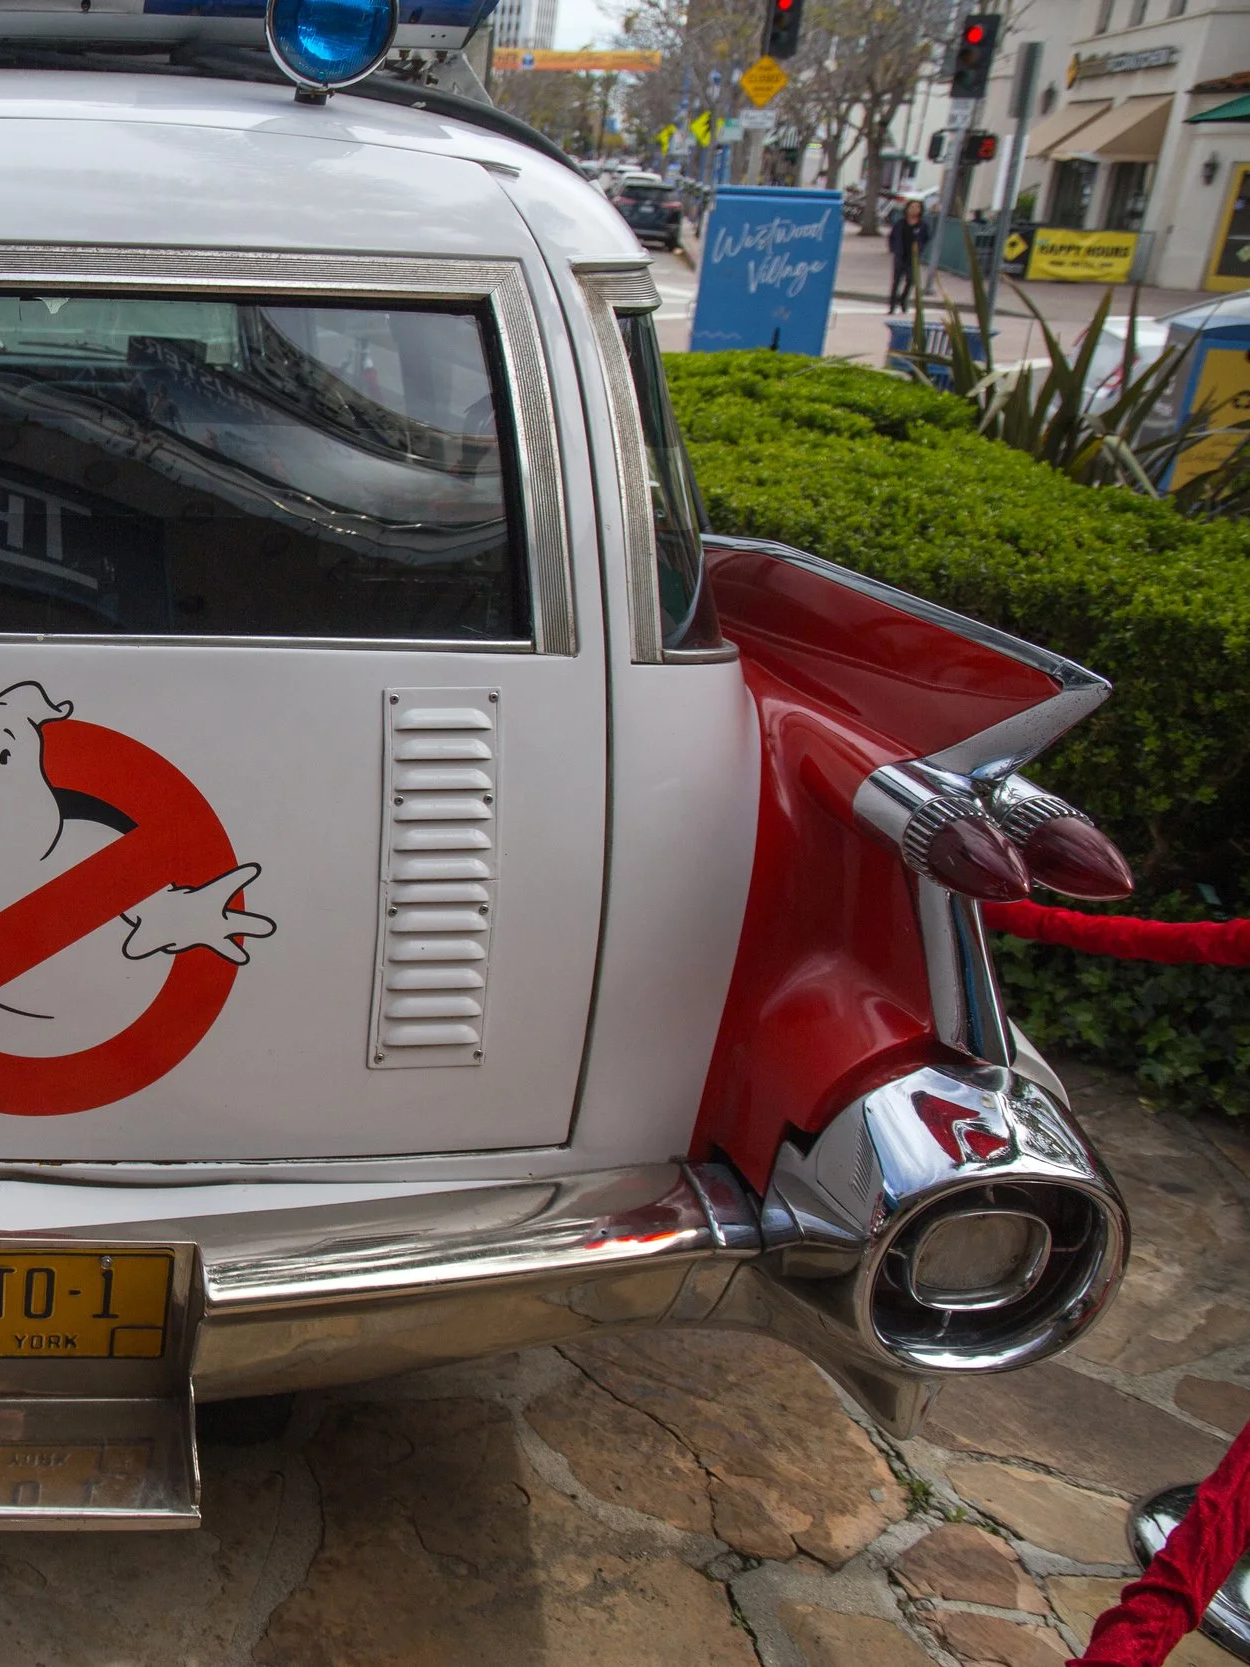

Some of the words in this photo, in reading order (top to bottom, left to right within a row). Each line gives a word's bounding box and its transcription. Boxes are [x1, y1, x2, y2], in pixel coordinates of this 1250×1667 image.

[711, 207, 832, 264] Westwood
[748, 251, 828, 298] Village
[14, 1334, 79, 1350] YORK
